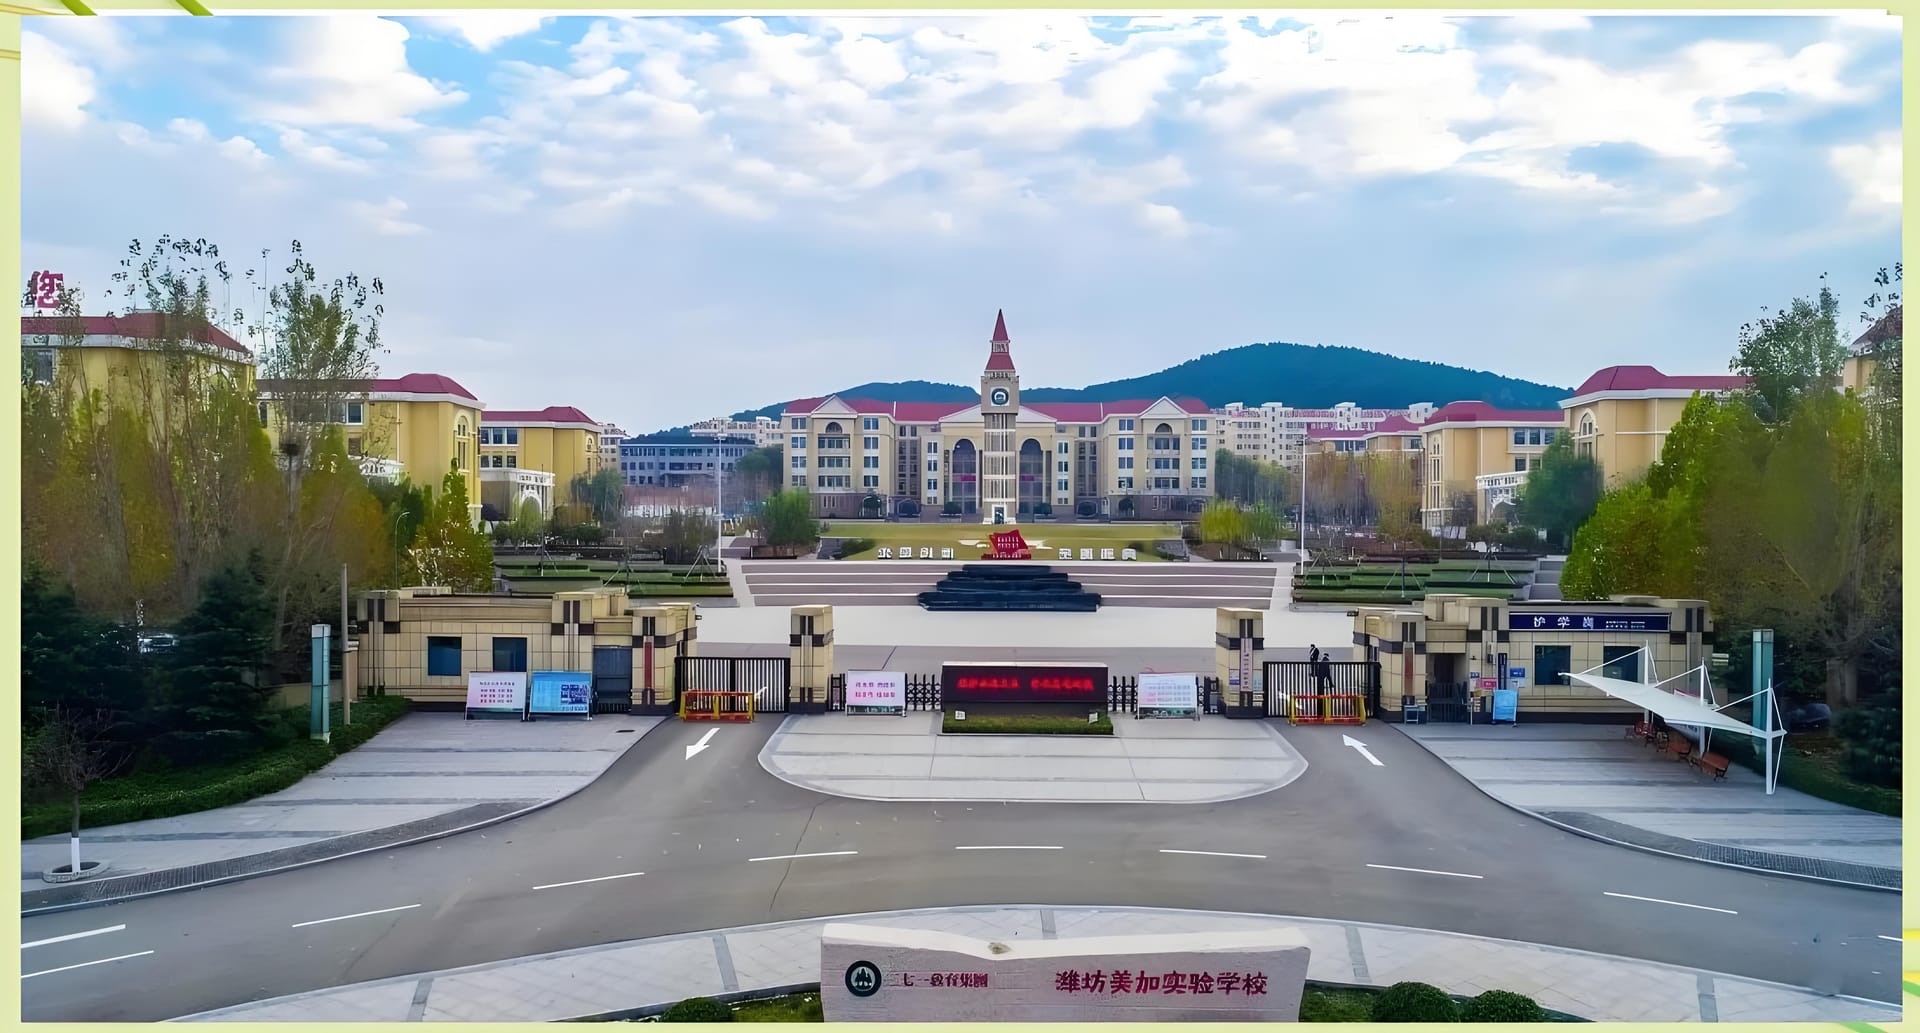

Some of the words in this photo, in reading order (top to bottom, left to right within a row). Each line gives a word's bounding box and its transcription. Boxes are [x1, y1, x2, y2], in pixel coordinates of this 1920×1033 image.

[1055, 969, 1269, 996] 潍坊美加实验学校
